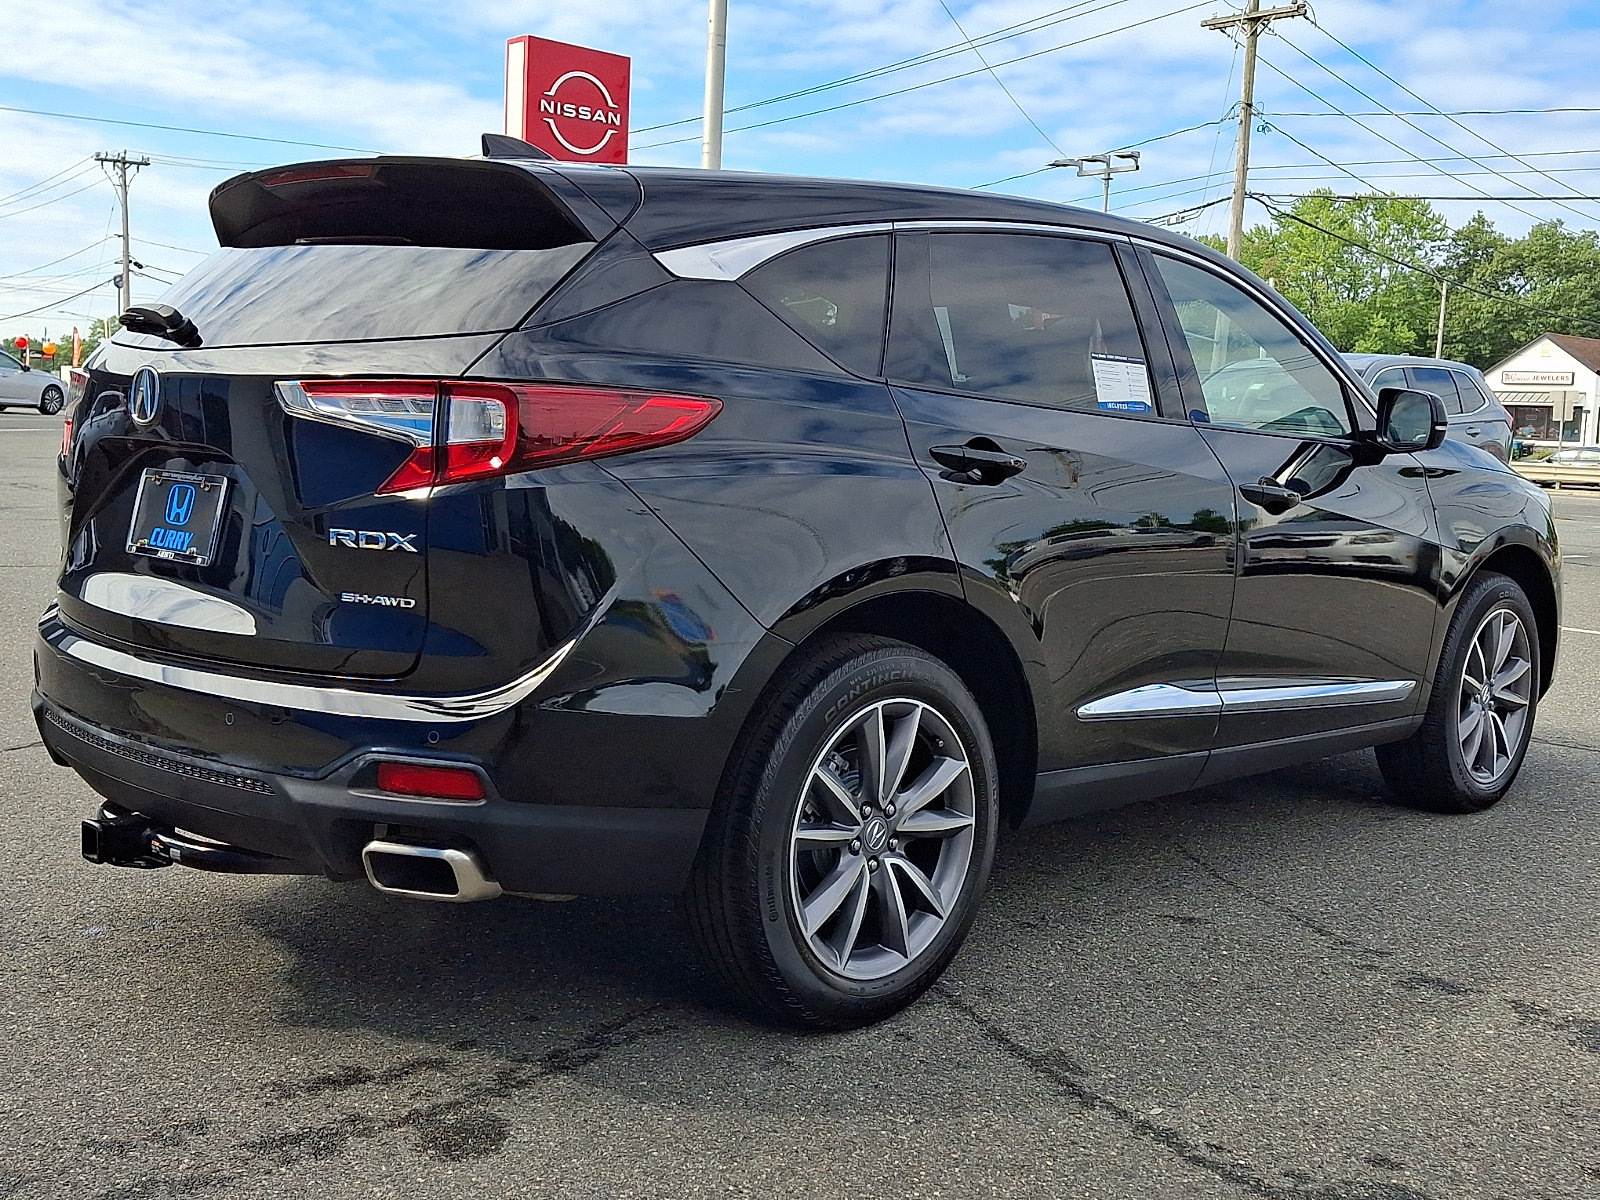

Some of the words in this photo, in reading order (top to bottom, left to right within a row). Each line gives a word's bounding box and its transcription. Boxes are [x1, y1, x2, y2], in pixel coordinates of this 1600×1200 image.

[540, 98, 621, 126] NISSAN
[149, 527, 194, 551] CURRY
[329, 528, 418, 552] RDX
[341, 592, 416, 608] SH-AWD
